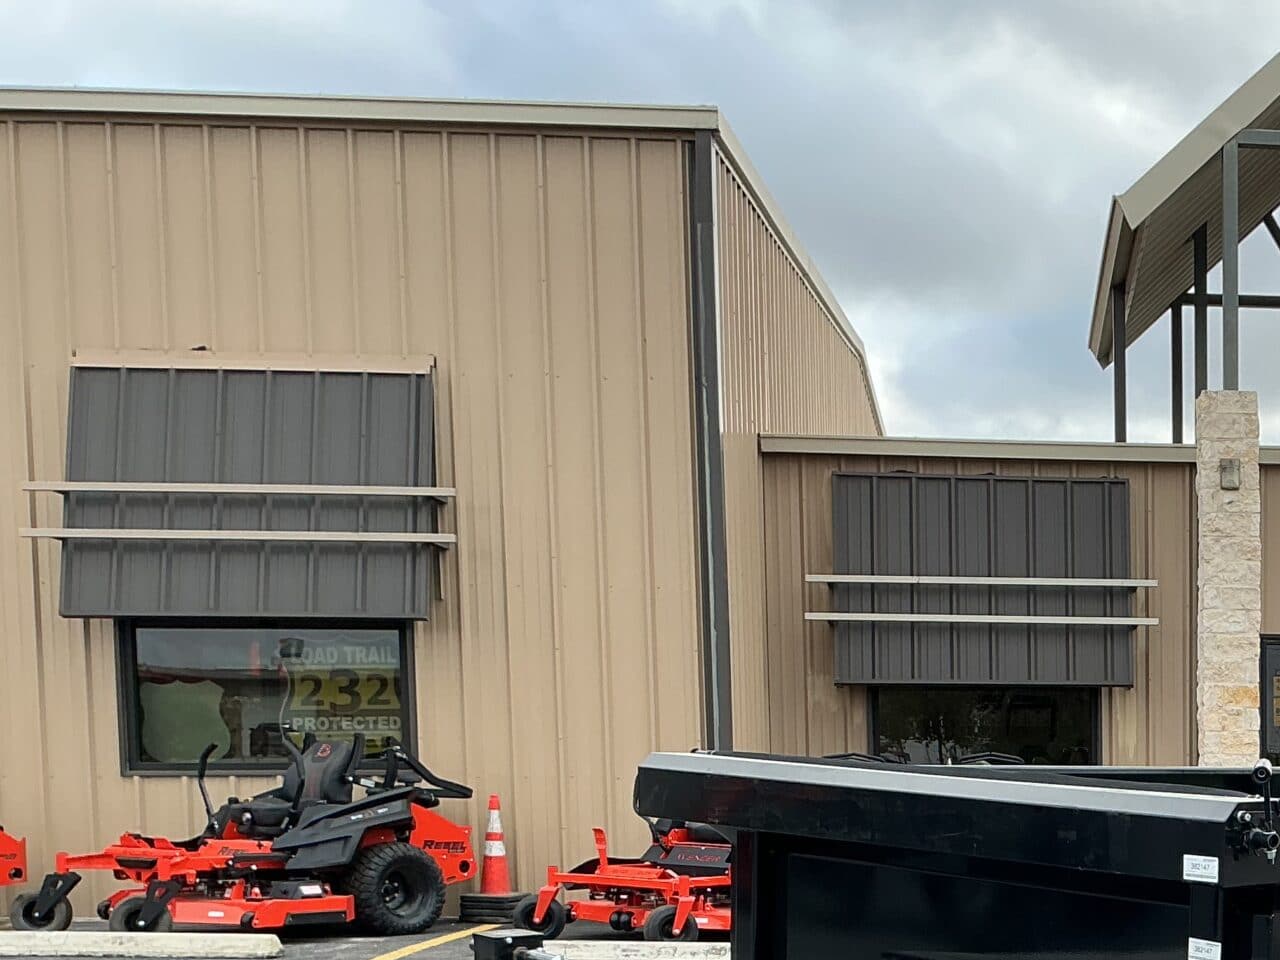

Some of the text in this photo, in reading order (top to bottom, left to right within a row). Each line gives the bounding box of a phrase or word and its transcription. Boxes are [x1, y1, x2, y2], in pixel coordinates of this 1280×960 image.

[290, 645, 398, 663] LOAD TRAIL
[300, 669, 391, 714] 232
[292, 716, 401, 731] PROTECTED
